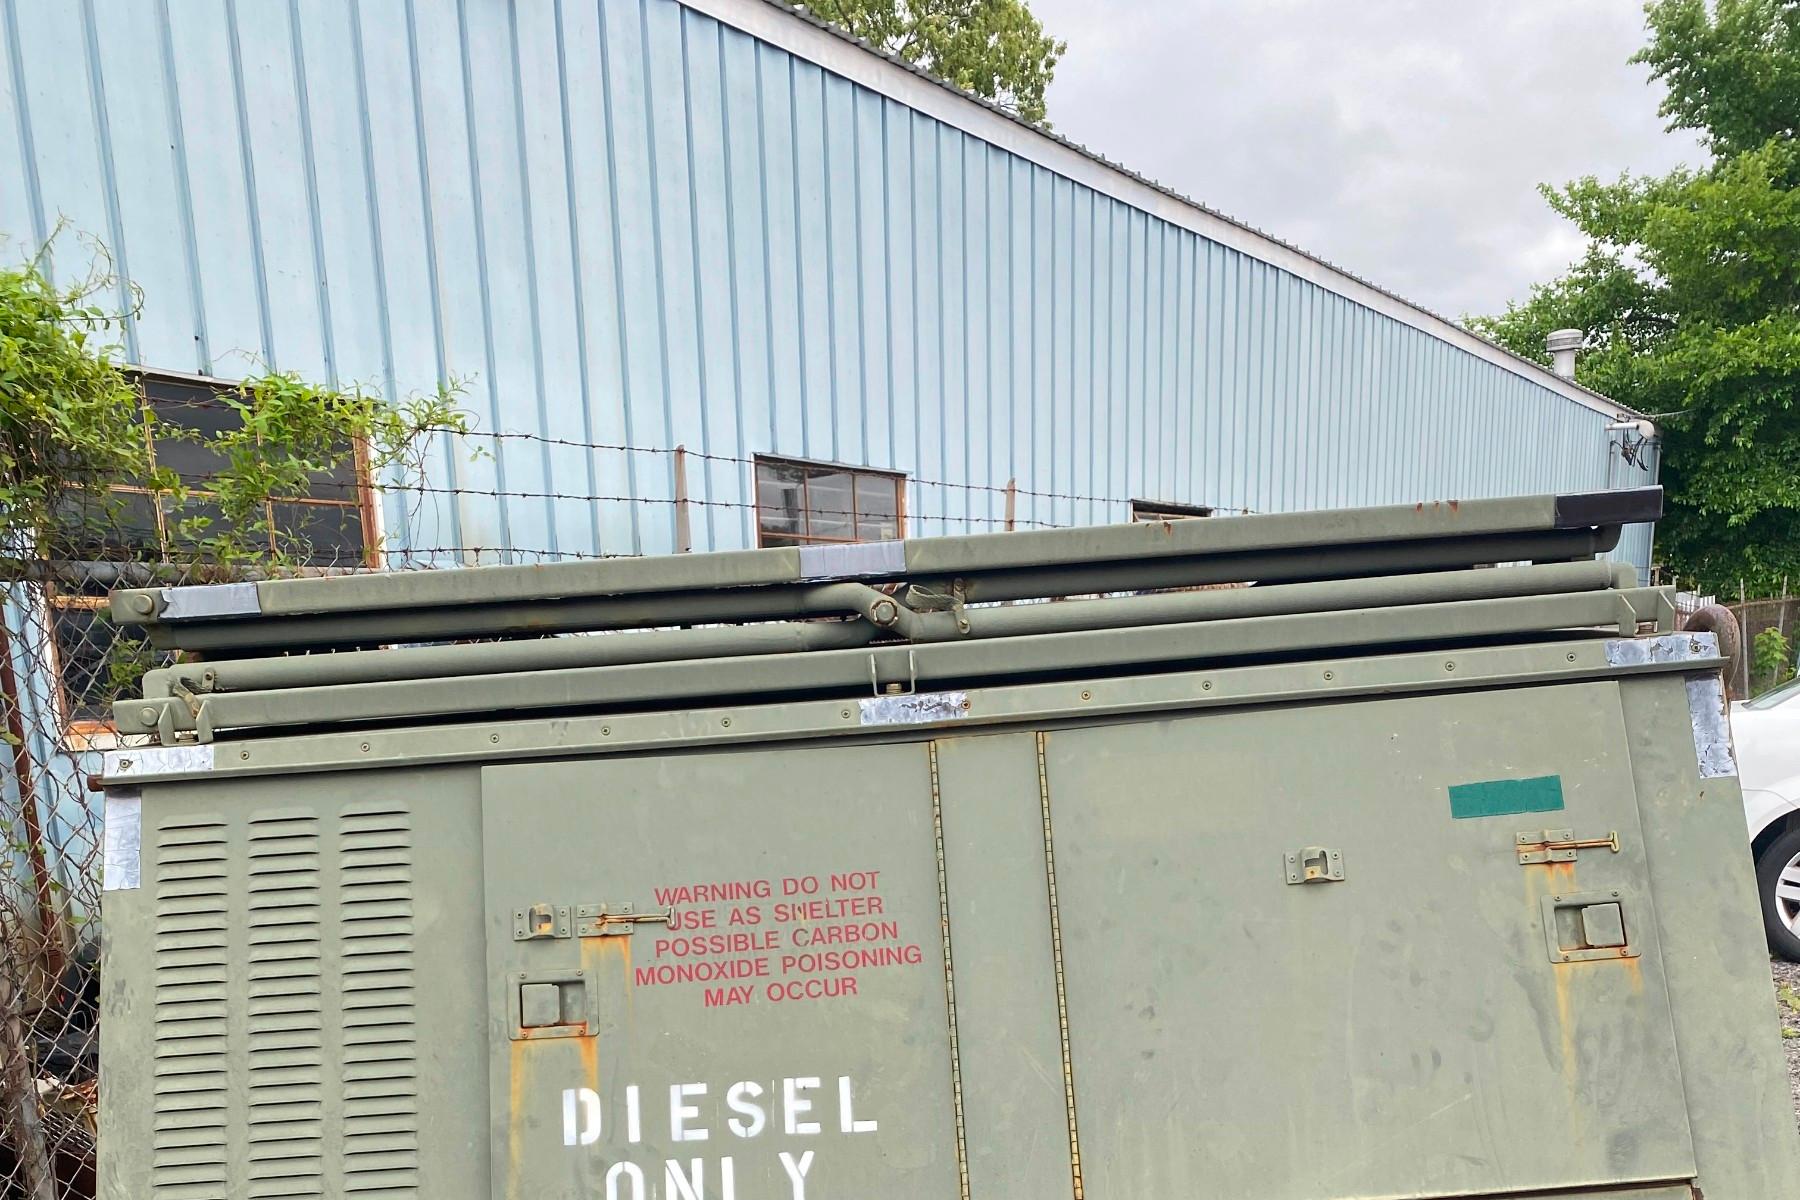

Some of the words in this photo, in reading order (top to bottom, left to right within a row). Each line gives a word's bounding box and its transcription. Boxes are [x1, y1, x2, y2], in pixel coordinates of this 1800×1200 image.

[654, 880, 771, 906] WARNING
[783, 876, 819, 896] DO
[831, 871, 880, 893] NOT
[668, 910, 716, 931] USE
[729, 906, 762, 926] AS
[774, 896, 883, 923] SHELTER
[655, 930, 780, 958] POSSIBLE
[792, 921, 898, 947] CARBON
[635, 957, 770, 987] MONOXIDE
[782, 945, 922, 974] POISONING
[704, 985, 755, 1007] MAY
[767, 977, 857, 1002] OCCUR
[562, 1076, 878, 1146] DIESEL
